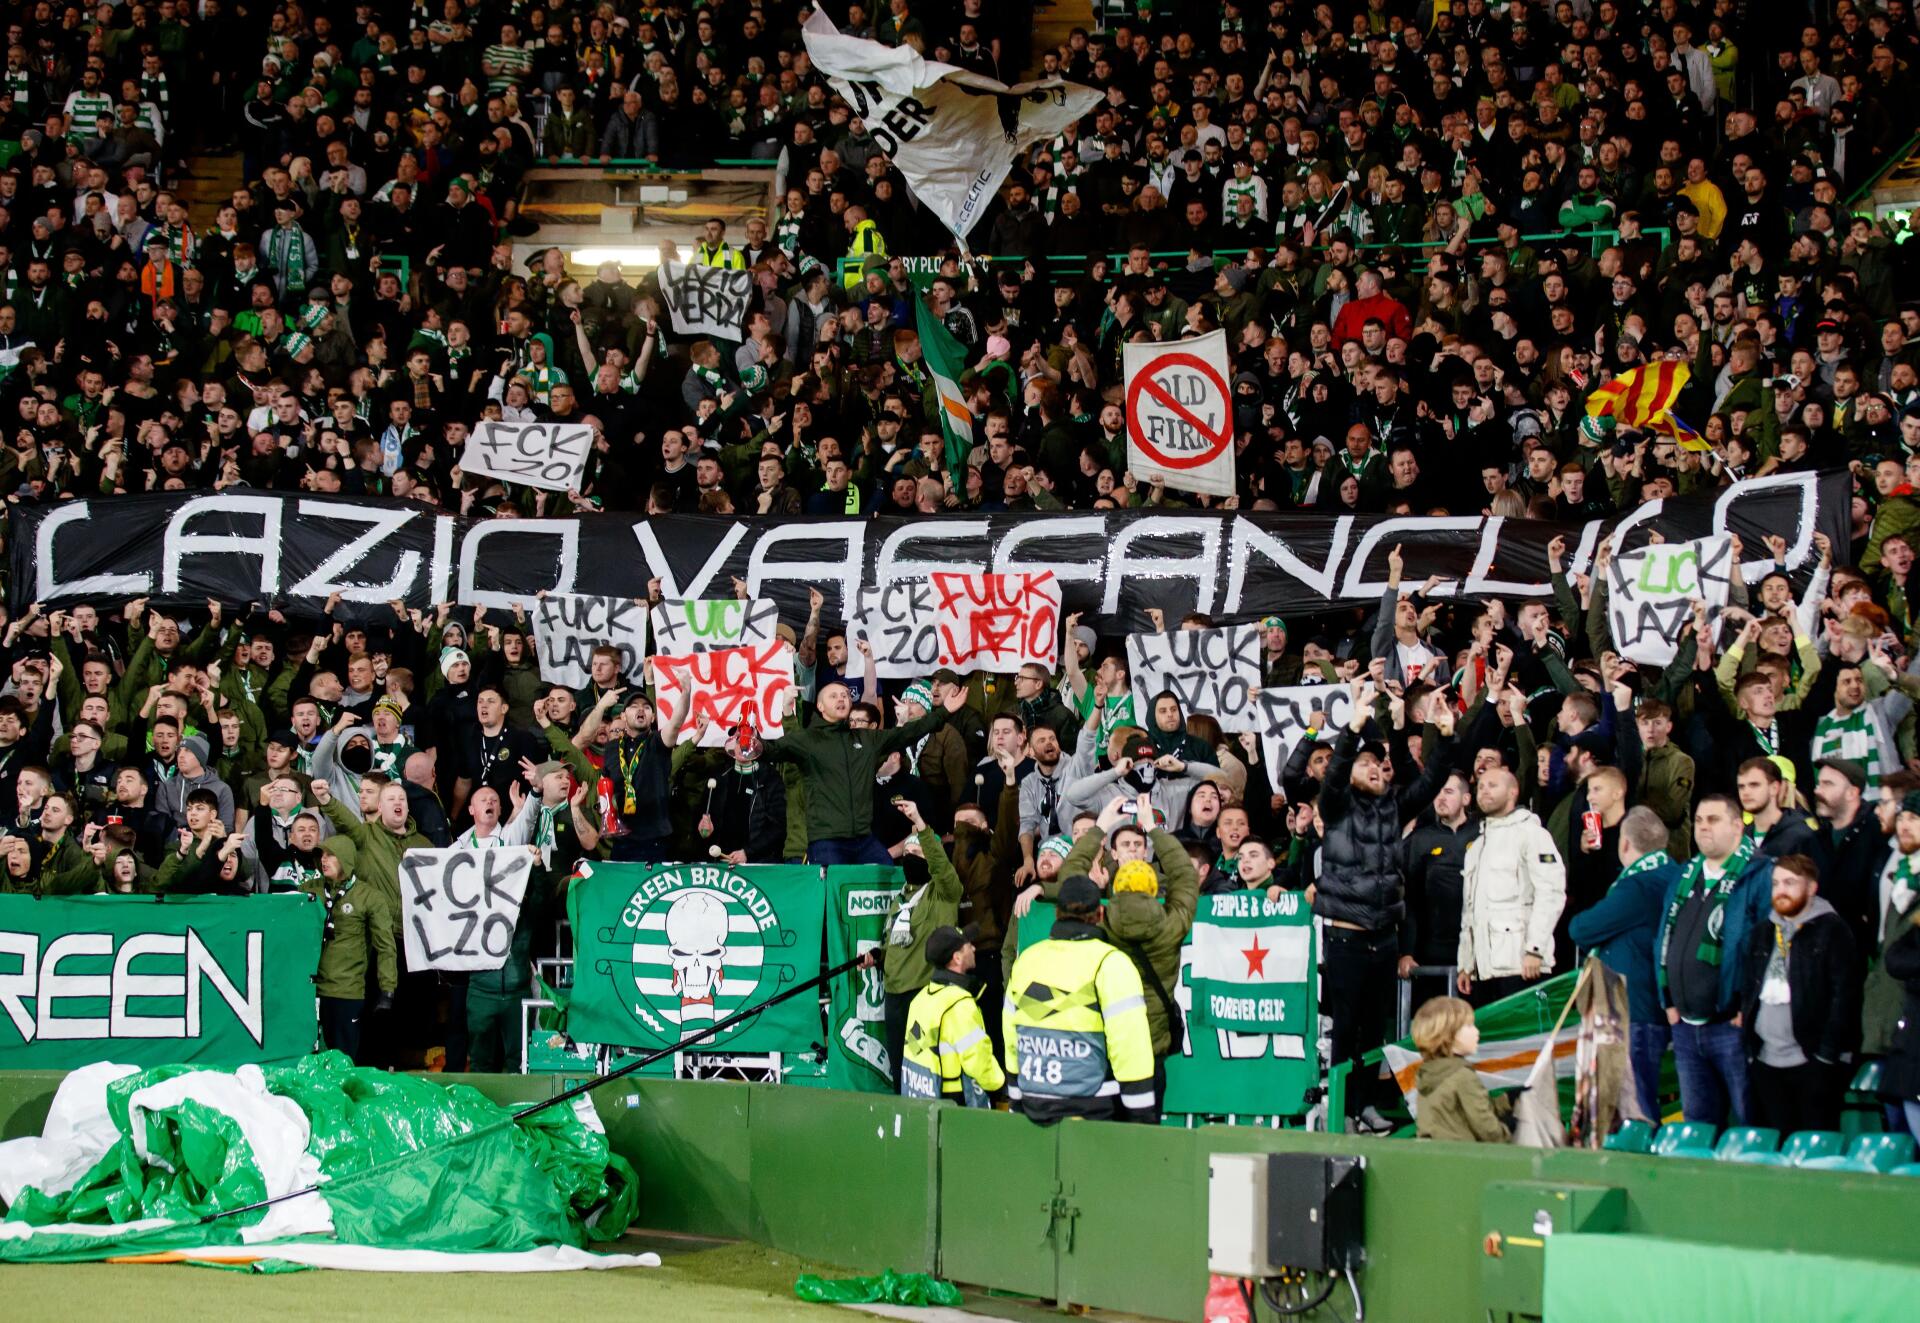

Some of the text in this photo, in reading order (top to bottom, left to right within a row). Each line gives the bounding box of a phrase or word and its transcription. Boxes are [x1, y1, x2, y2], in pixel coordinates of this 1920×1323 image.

[958, 168, 993, 224] CELTIC
[920, 256, 966, 274] PLOH
[1150, 374, 1207, 408] OLD
[479, 422, 589, 459] FCK
[1147, 412, 1216, 451] FIRM
[34, 494, 582, 612] LAZIO
[1609, 537, 1730, 602] FUCK
[852, 582, 935, 625] FCK
[930, 568, 1058, 619] FUCK
[539, 595, 647, 638] FUCK
[656, 599, 779, 642] FUCK
[653, 640, 794, 693] FUCK
[1133, 627, 1262, 674] FUCK
[1258, 689, 1351, 740] FUC
[400, 849, 528, 912] FCK
[621, 866, 778, 932] GREEN BRIGADE
[1211, 893, 1250, 918] TEMPLE
[411, 910, 515, 962] LZO
[1210, 994, 1286, 1022] FOREVER CELTIC
[1017, 1035, 1092, 1059] EWARD
[1020, 1056, 1063, 1085] 418
